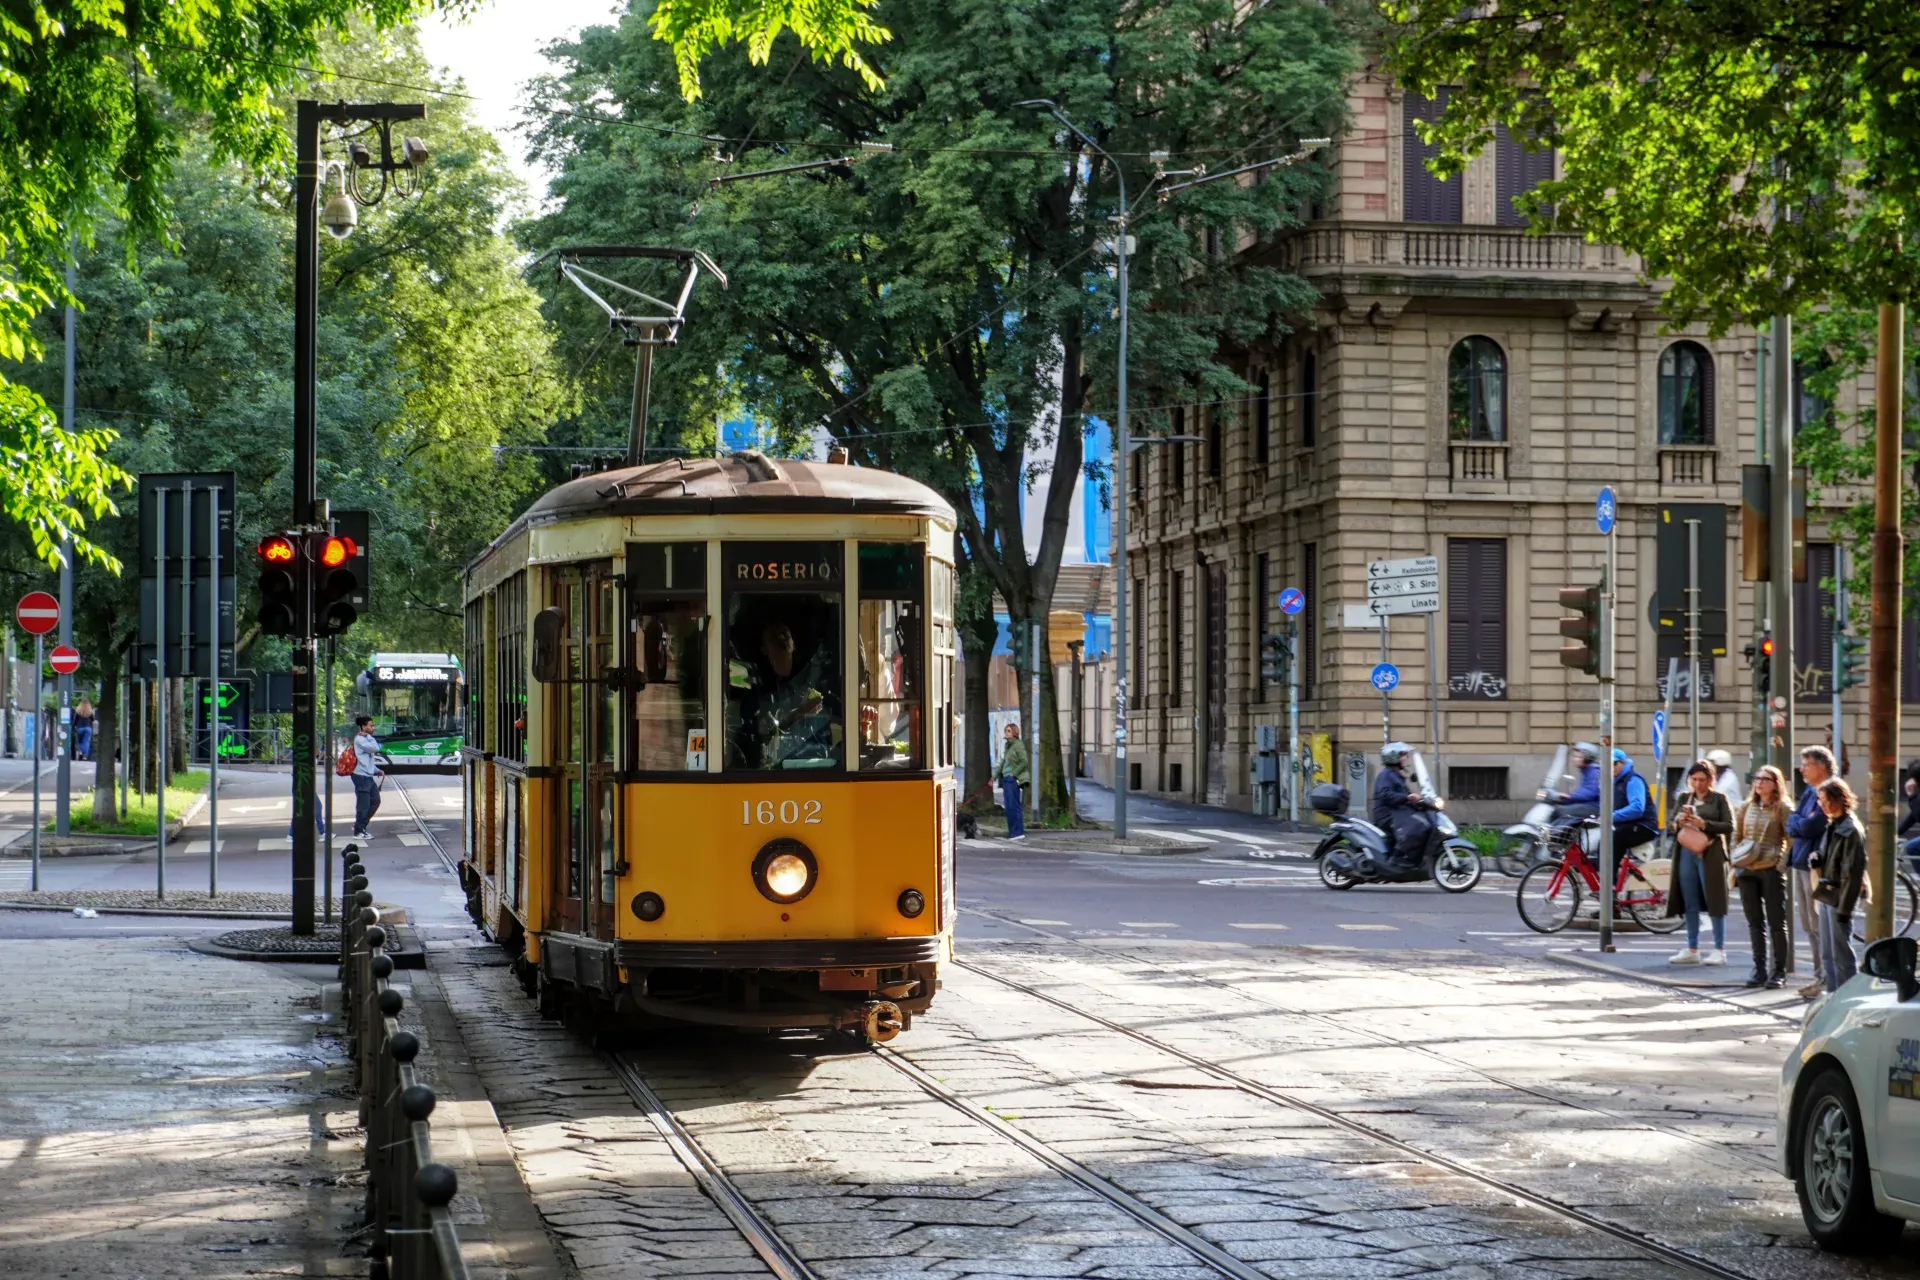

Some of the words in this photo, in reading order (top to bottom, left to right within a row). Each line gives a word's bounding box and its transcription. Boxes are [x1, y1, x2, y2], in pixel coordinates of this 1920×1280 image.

[737, 563, 831, 579] ROSERIO
[1409, 581, 1417, 589] S.
[1420, 579, 1436, 588] Siro
[1411, 598, 1437, 608] Linate
[379, 668, 393, 680] 85
[692, 738, 705, 751] 14
[694, 753, 701, 767] 1
[742, 800, 822, 825] 1602
